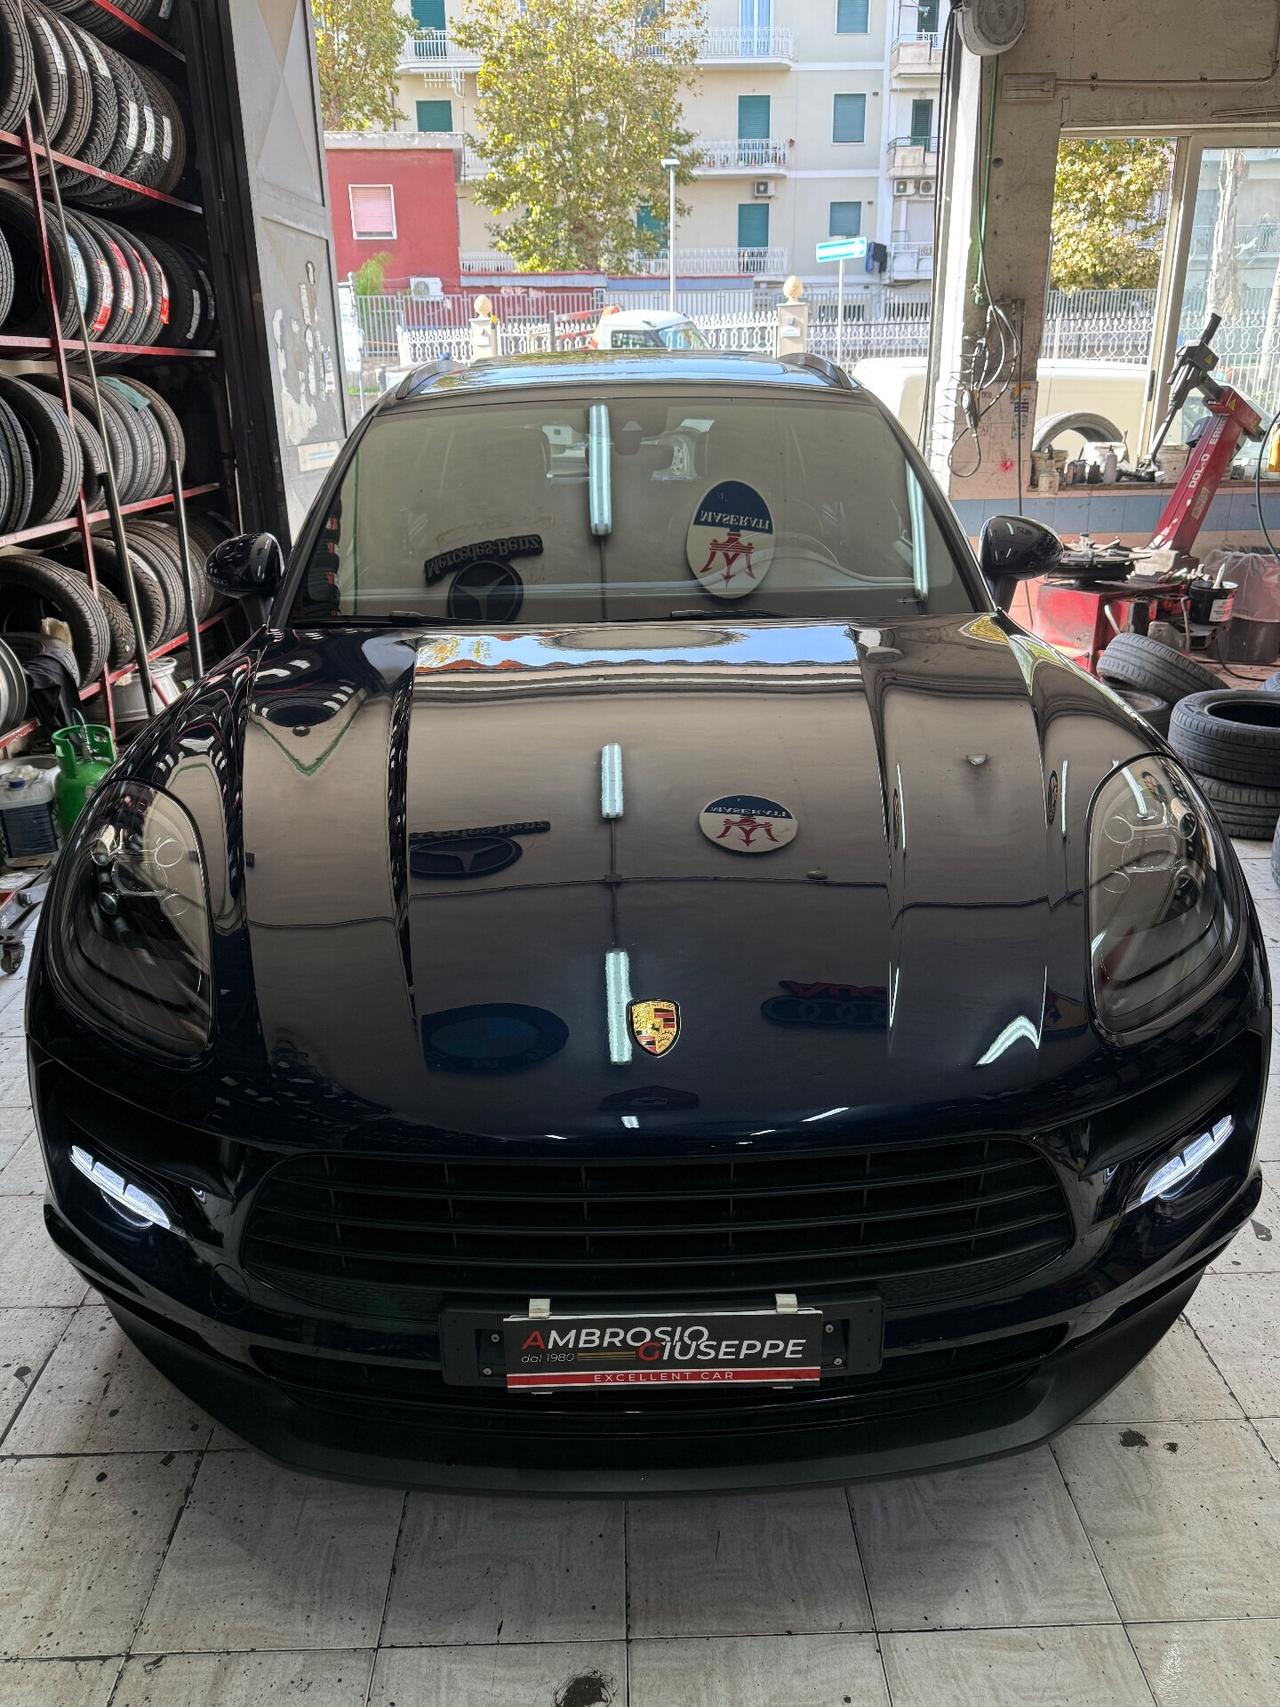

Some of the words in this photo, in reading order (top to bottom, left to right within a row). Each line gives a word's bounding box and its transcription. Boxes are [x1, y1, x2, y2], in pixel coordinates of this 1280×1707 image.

[521, 1326, 709, 1350] AMBROSIO
[521, 1353, 543, 1364] dal
[546, 1353, 575, 1363] 1980
[638, 1339, 807, 1361] GIUSEPPE
[594, 1372, 691, 1383] EXCELLENT
[701, 1371, 734, 1381] CAR
